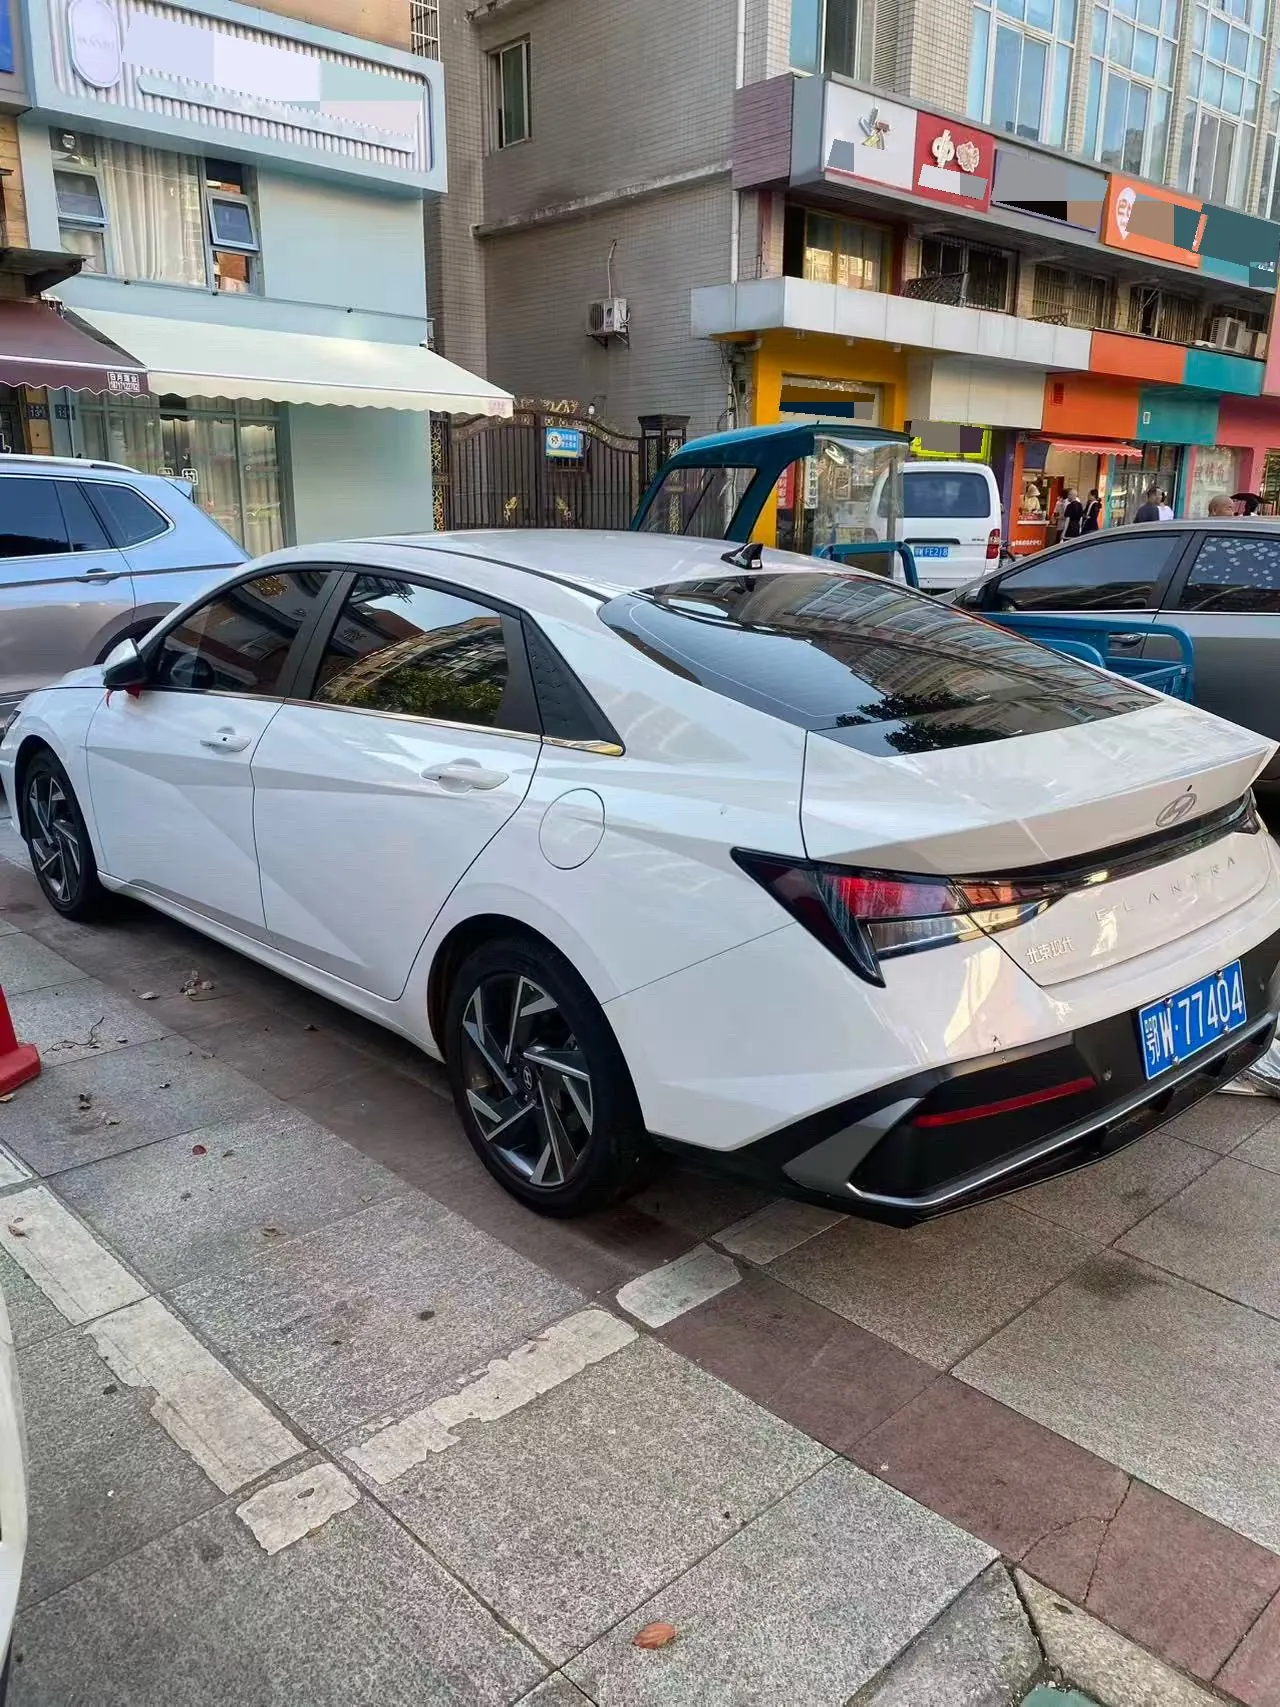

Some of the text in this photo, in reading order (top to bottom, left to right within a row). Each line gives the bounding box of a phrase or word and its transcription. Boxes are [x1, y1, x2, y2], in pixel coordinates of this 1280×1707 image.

[1094, 856, 1236, 922] ELANTRA
[1026, 936, 1075, 966] 北京现代
